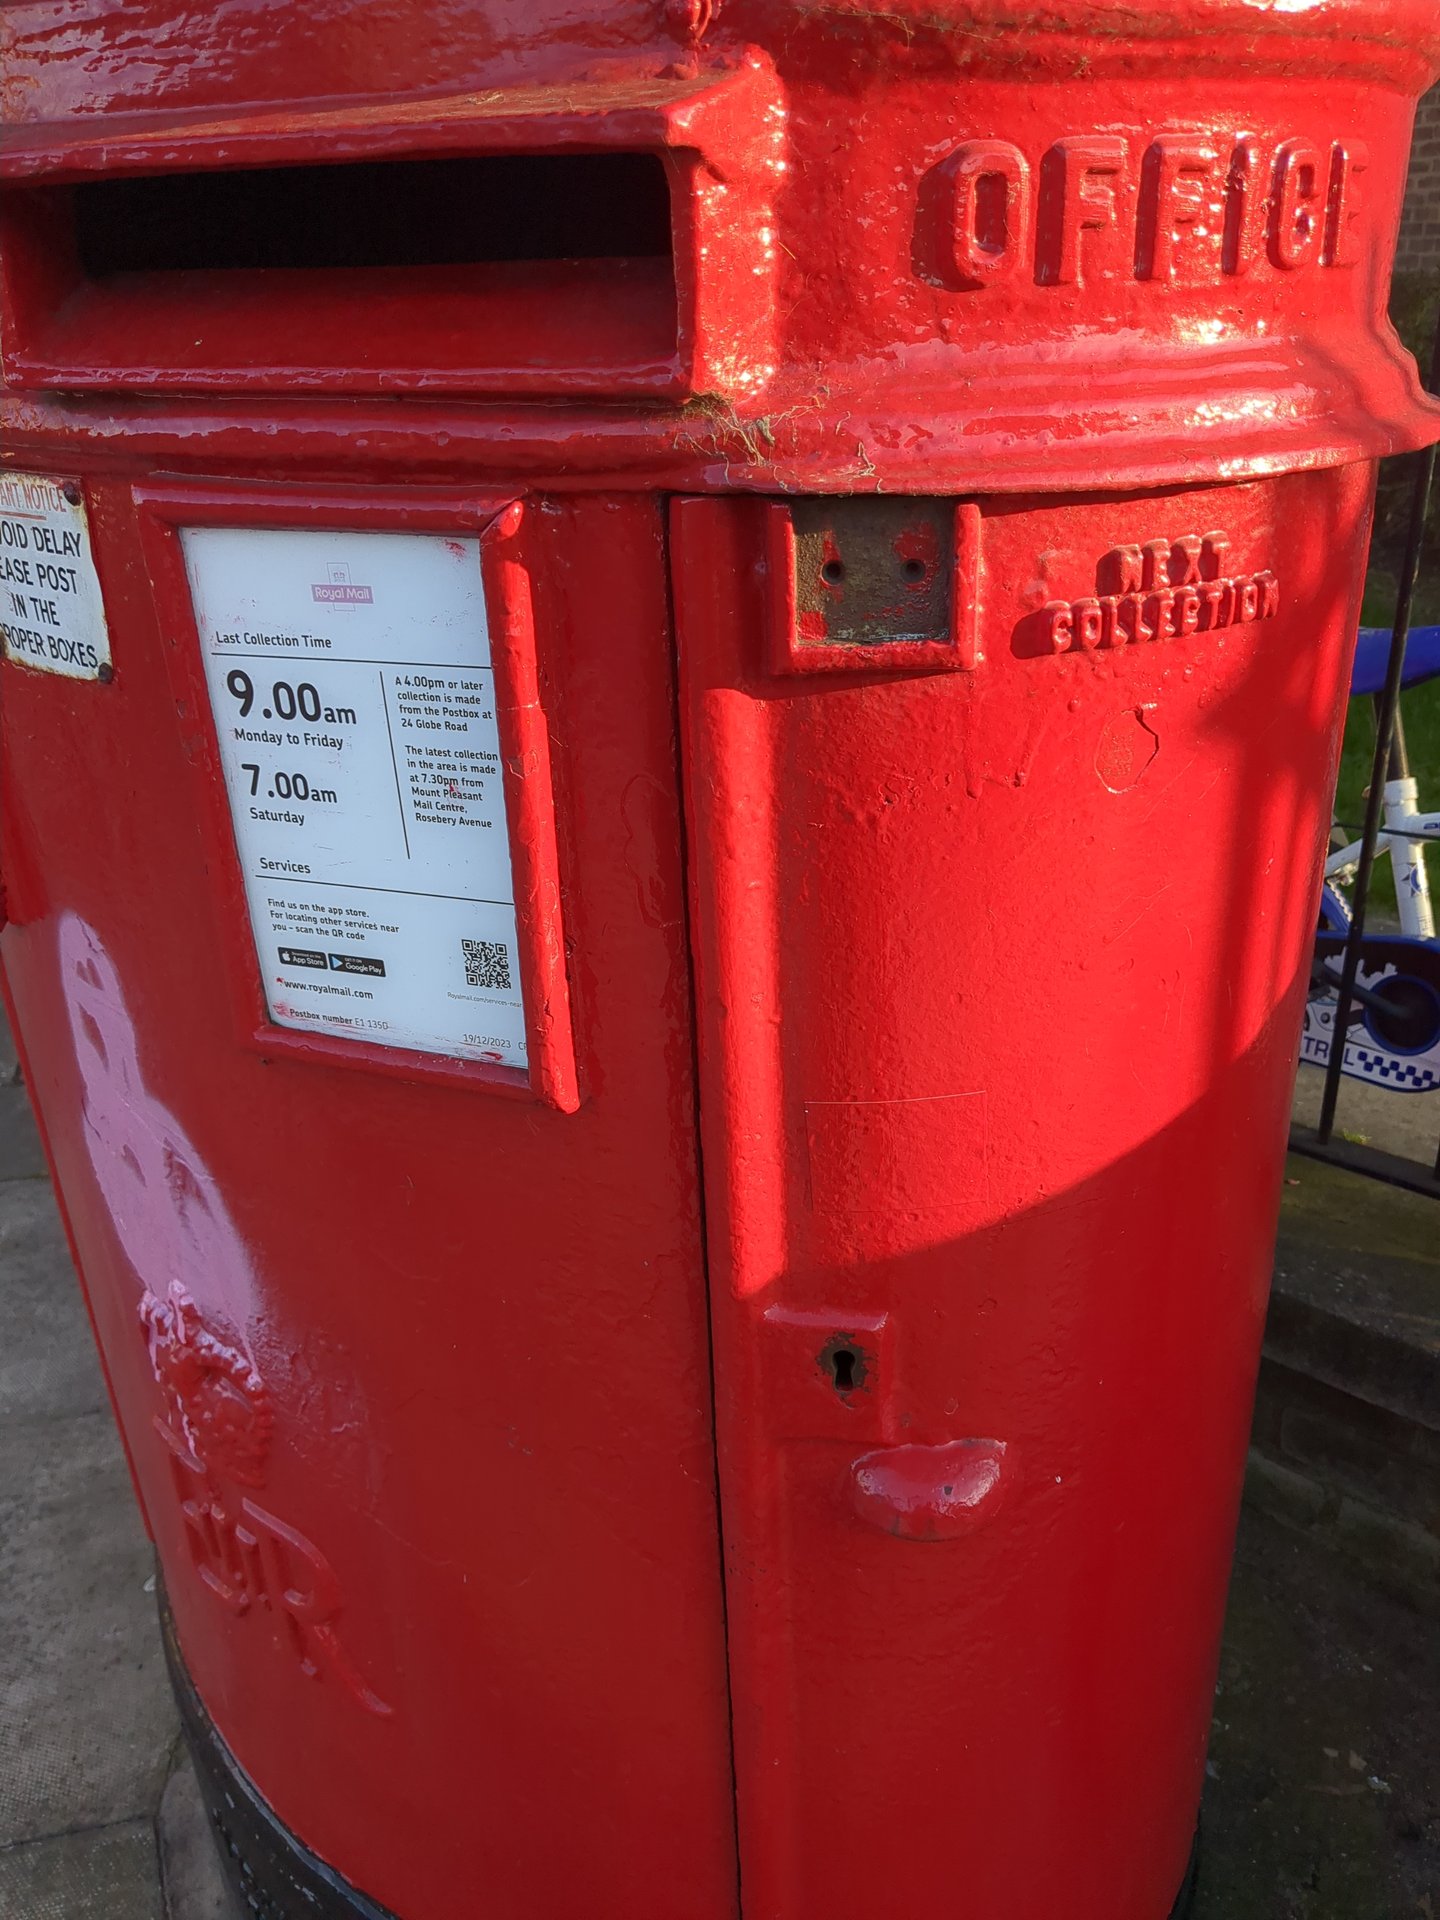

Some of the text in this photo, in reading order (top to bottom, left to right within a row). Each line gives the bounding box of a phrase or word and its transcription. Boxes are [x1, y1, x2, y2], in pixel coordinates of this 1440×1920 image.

[952, 133, 1368, 290] OFFICE
[22, 484, 66, 512] NOTICE
[0, 521, 81, 557] OID DELAY
[1114, 530, 1231, 593] NEXT
[37, 564, 78, 594] POST
[315, 587, 370, 600] Royal Mail
[12, 593, 60, 626] IN THE
[1045, 569, 1279, 653] COLLECTION
[0, 623, 98, 668] ROPER BOXES
[216, 631, 332, 648] Last Collection Time
[395, 676, 483, 691] A 4.00pm or later
[226, 670, 357, 725] 9.00am
[397, 690, 480, 704] collection is made
[399, 704, 492, 719] from the Postbox at
[401, 718, 468, 731] 24 Globe Road
[234, 728, 343, 750] Monday to Friday
[405, 746, 498, 761] The latest collection
[407, 759, 496, 774] in the area is made
[241, 764, 336, 804] 7.00am
[410, 774, 484, 788] at 7.30pm from
[412, 787, 482, 801] Mount Pleasant
[414, 800, 468, 813] Mail Centre,
[250, 808, 305, 825] Saturday
[415, 812, 492, 828] Rosebery Avenue
[260, 858, 311, 874] Services
[268, 899, 285, 909] Find
[288, 902, 297, 910] us
[311, 903, 326, 913] the
[329, 906, 344, 916] app
[346, 908, 369, 918] store.
[270, 910, 399, 933] For locating other services near
[273, 923, 287, 932] you
[296, 926, 314, 935] scan
[316, 926, 330, 936] the
[332, 929, 344, 939] QR
[347, 931, 365, 941] code
[307, 958, 324, 966] Store
[346, 963, 382, 975] Google Play
[284, 980, 373, 1000] www.royalmail.com
[290, 1008, 320, 1021] Postbox
[322, 1013, 352, 1025] number
[463, 1033, 512, 1049] 19/12/2023
[1304, 1036, 1354, 1066] TRL
